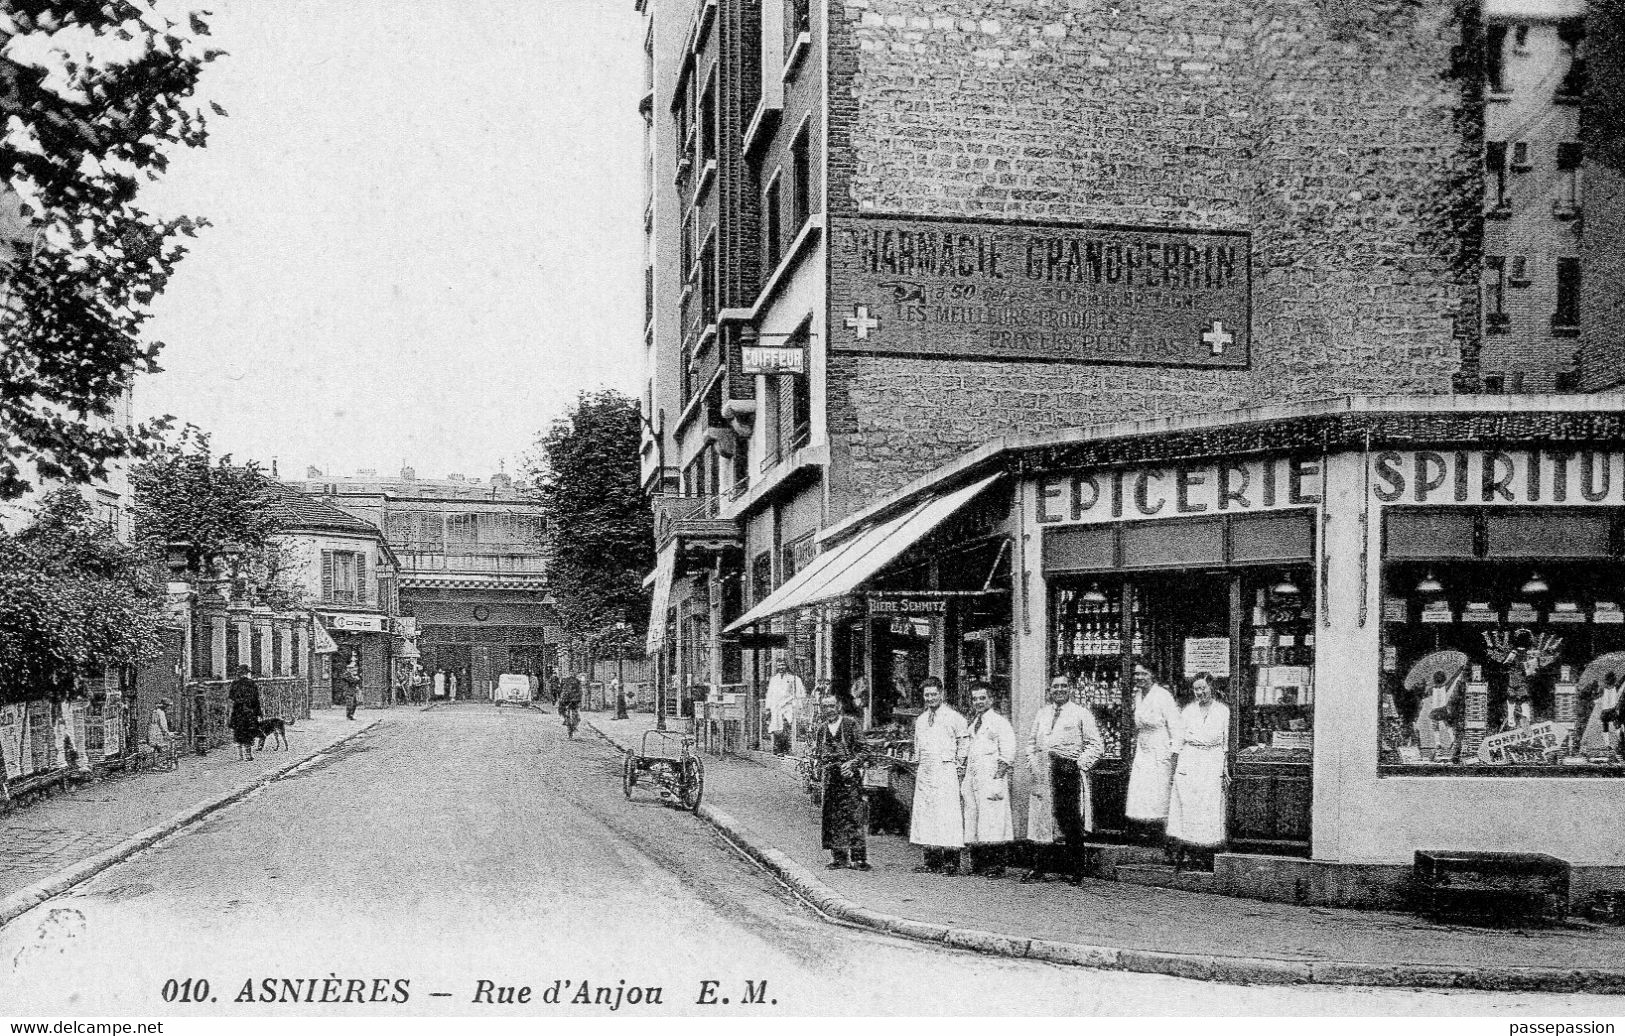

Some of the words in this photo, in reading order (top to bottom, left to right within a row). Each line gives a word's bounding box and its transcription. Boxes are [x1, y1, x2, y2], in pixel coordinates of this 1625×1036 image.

[844, 228, 1004, 279] PHARMACIE
[1025, 236, 1236, 289] GRANDPERRIN
[951, 284, 976, 300] 50
[743, 350, 802, 366] COIFFEUR
[1035, 459, 1323, 524] EPICERIE
[1373, 449, 1625, 502] SPIRITU
[1488, 725, 1551, 748] CONFISRIE
